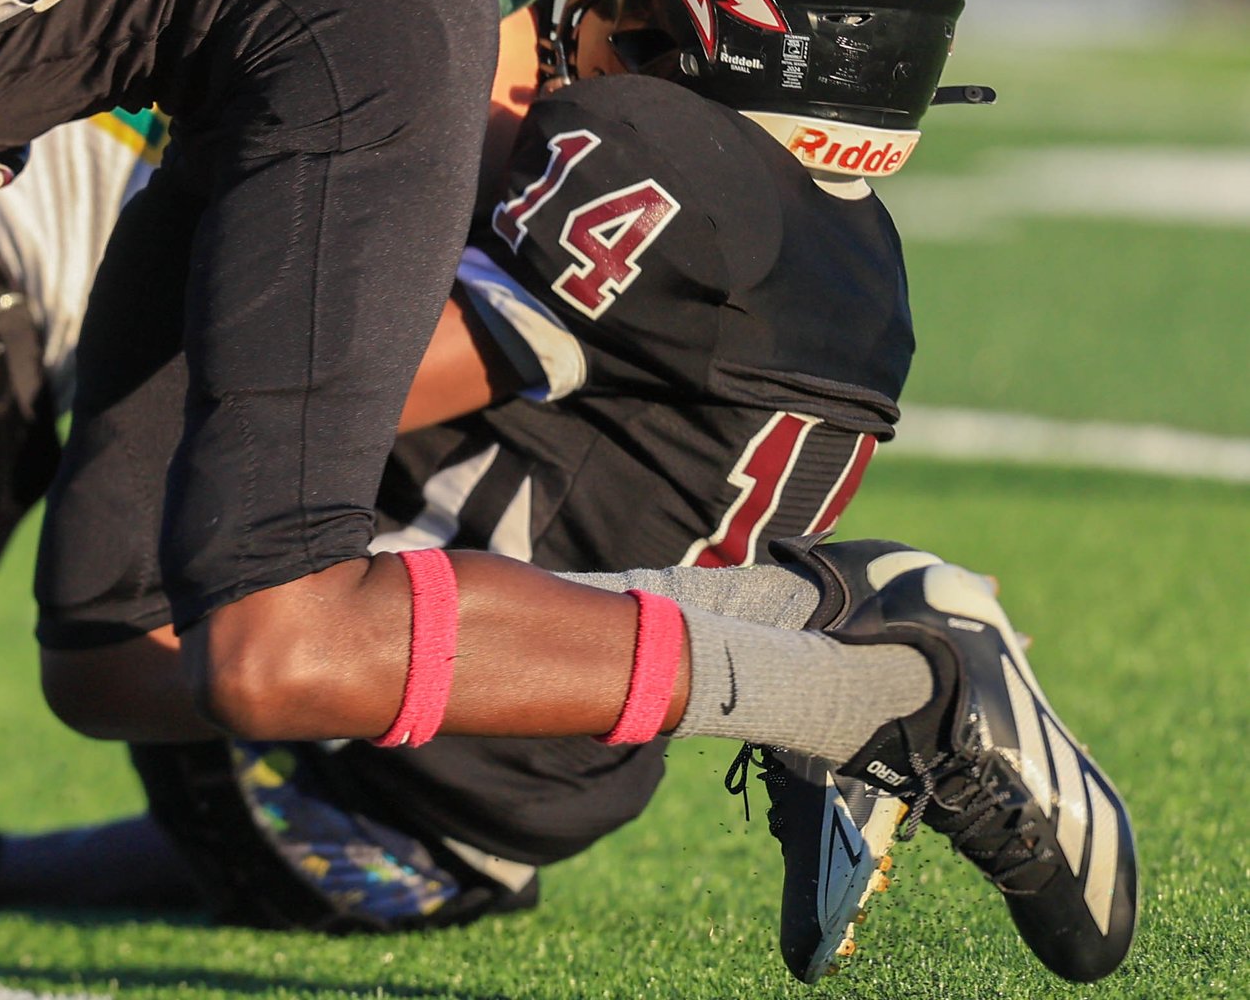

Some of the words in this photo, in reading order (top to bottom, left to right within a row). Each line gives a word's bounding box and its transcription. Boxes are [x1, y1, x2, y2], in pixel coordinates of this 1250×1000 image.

[720, 52, 761, 69] Riddell
[730, 64, 751, 74] SMALL
[492, 128, 681, 321] 14
